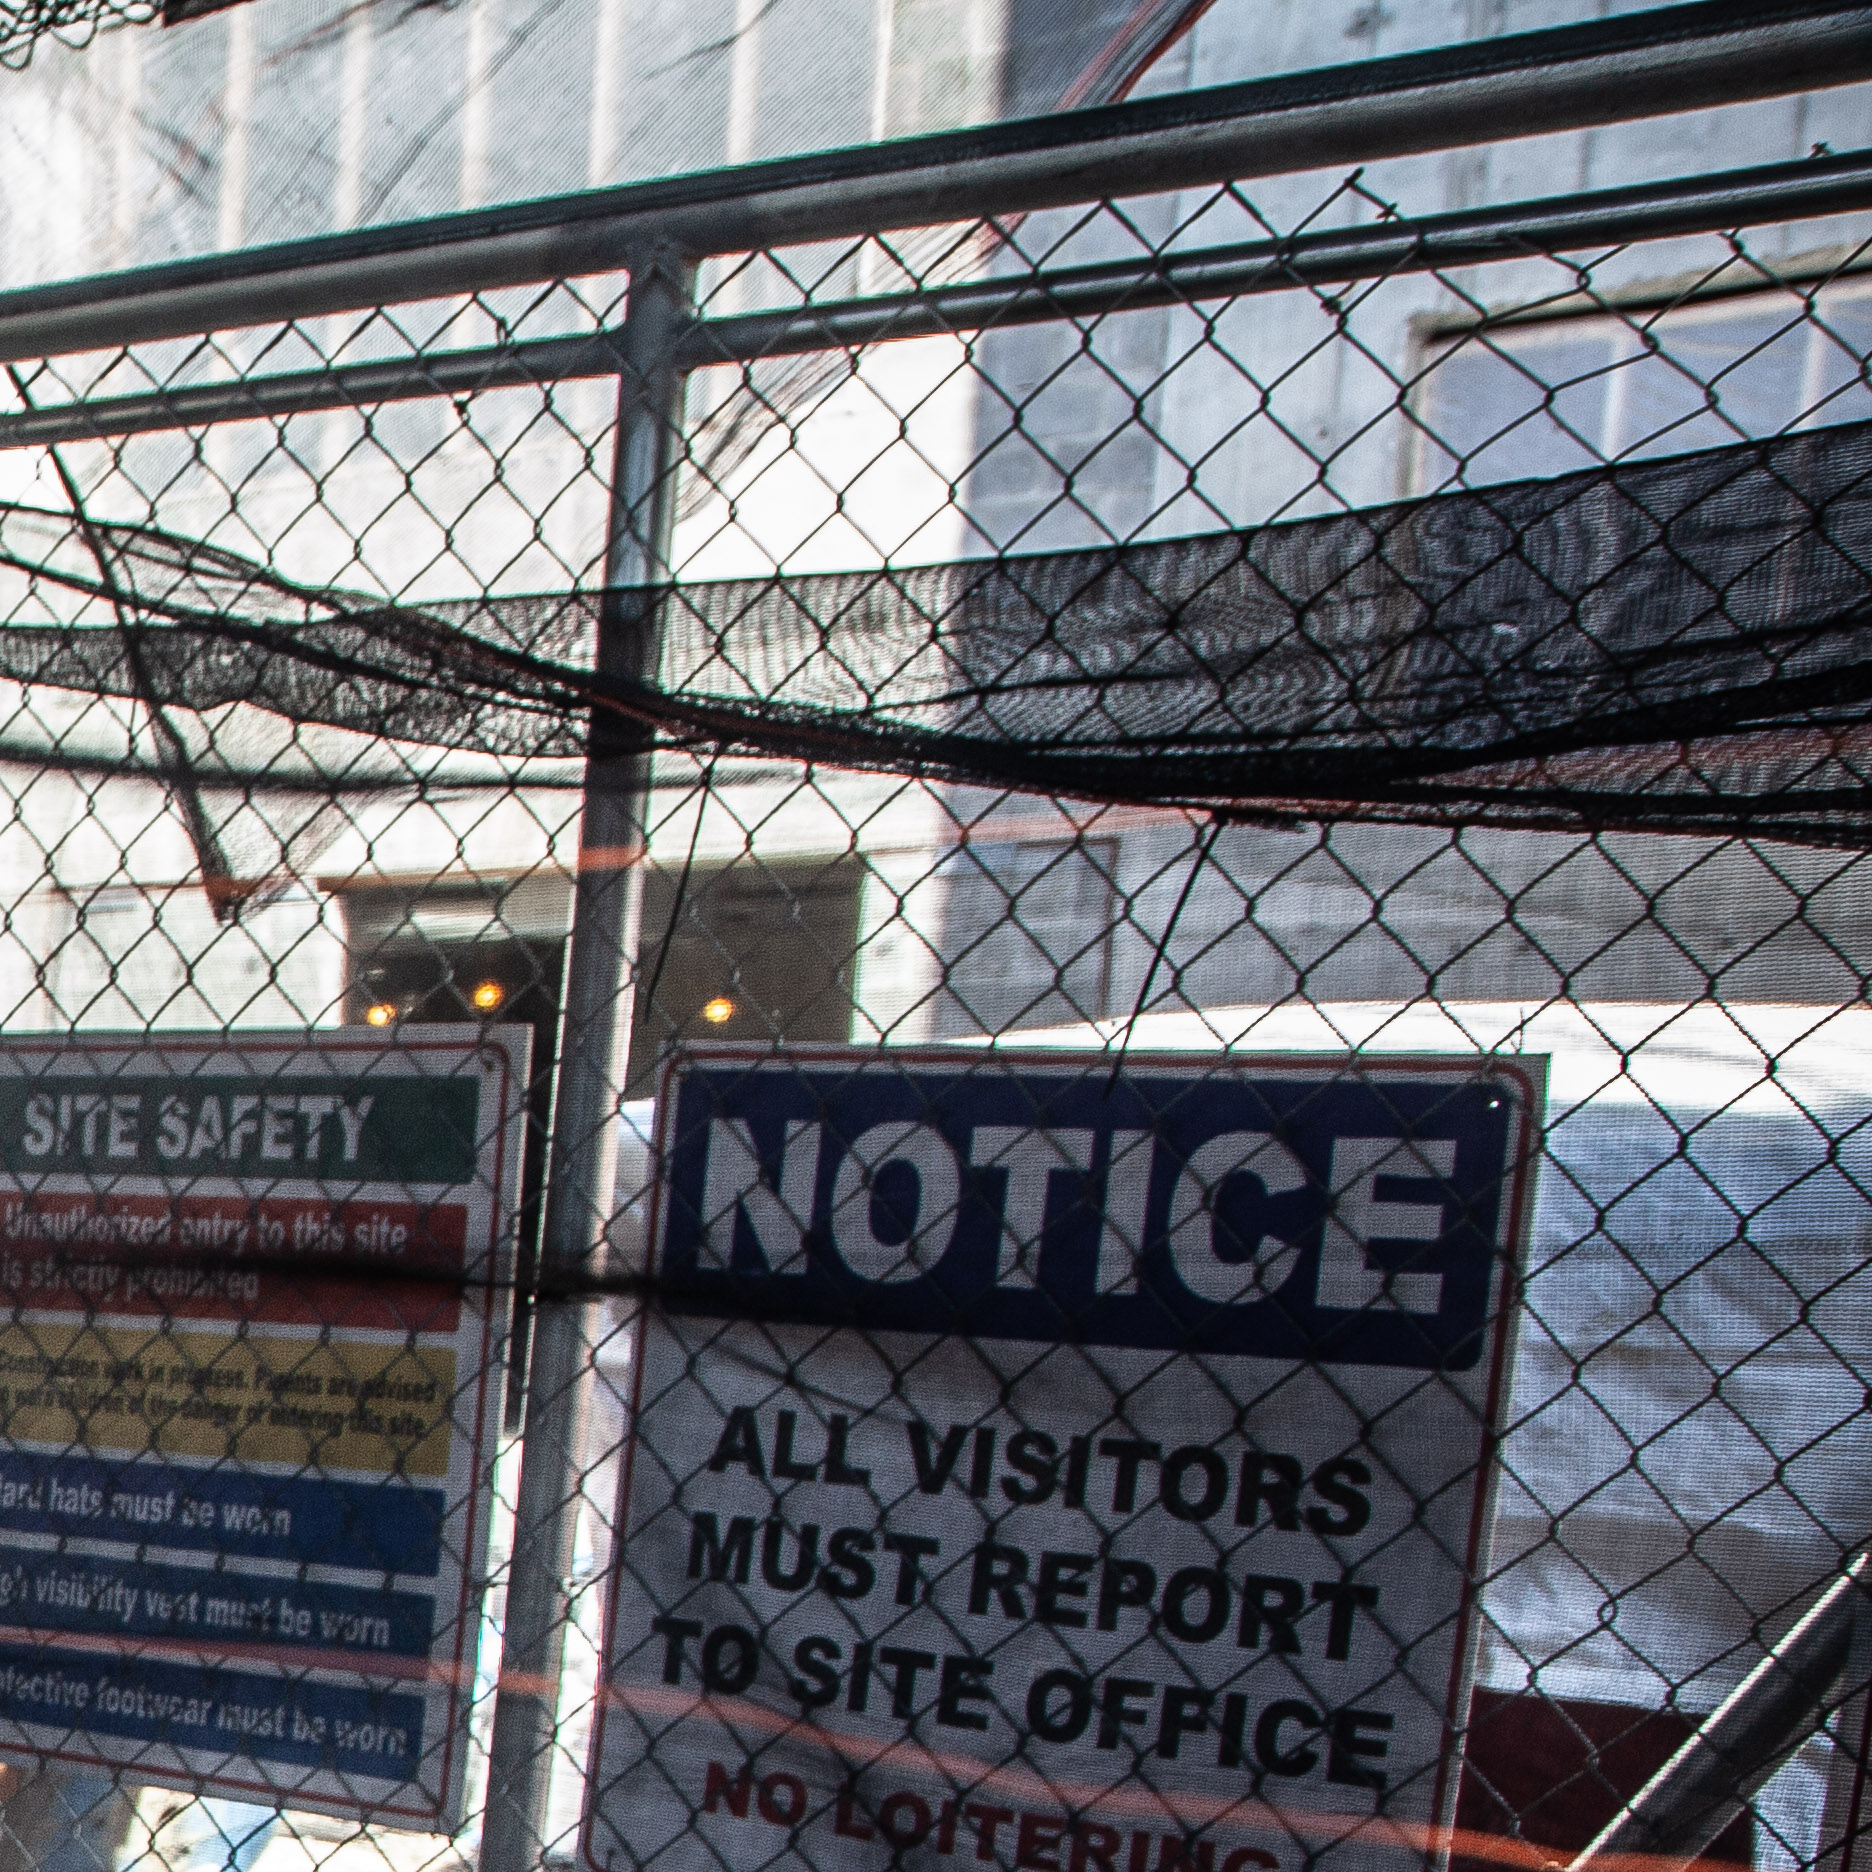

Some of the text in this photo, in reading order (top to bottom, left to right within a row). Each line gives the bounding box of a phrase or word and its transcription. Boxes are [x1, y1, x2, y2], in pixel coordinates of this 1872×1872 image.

[22, 1093, 375, 1162] SITE SAFETY
[5, 1202, 408, 1255] Unauthorized entry to this site
[697, 1115, 1457, 1315] NOTICE
[2, 1254, 23, 1288] is
[49, 1478, 103, 1518] hats
[112, 1489, 175, 1525] must
[706, 1404, 1373, 1538] ALL VISITORS
[688, 1512, 1379, 1662] MUST REPORT
[279, 1599, 312, 1637] be
[320, 1610, 390, 1646] worn
[216, 1698, 285, 1738] must
[293, 1706, 327, 1744] be
[334, 1718, 409, 1757] worn
[657, 1619, 1396, 1792] TO SITE OFFICE
[702, 1761, 807, 1826] NO
